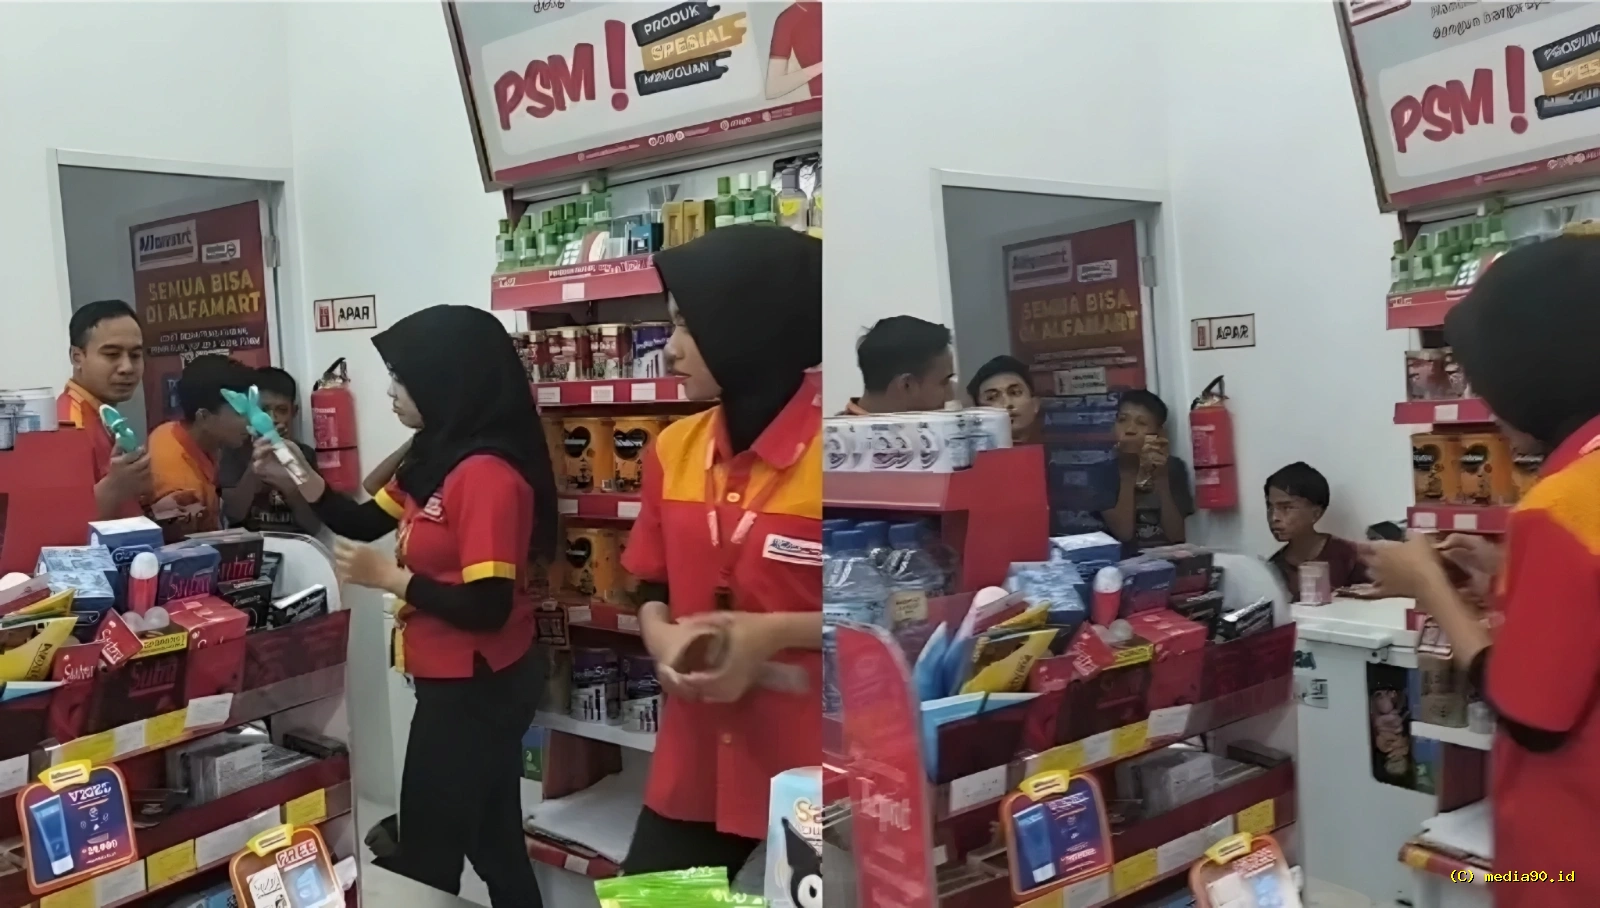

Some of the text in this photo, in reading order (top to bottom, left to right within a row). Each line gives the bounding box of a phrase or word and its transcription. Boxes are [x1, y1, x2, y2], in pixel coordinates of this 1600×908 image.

[644, 5, 700, 35] PRODUK
[651, 25, 732, 60] SPESIAL
[149, 268, 254, 301] SEMUA BISA
[1086, 288, 1132, 311] BISA
[147, 291, 261, 324] DI ALFAMART
[338, 306, 369, 323] APAR
[1216, 324, 1248, 340] APAR
